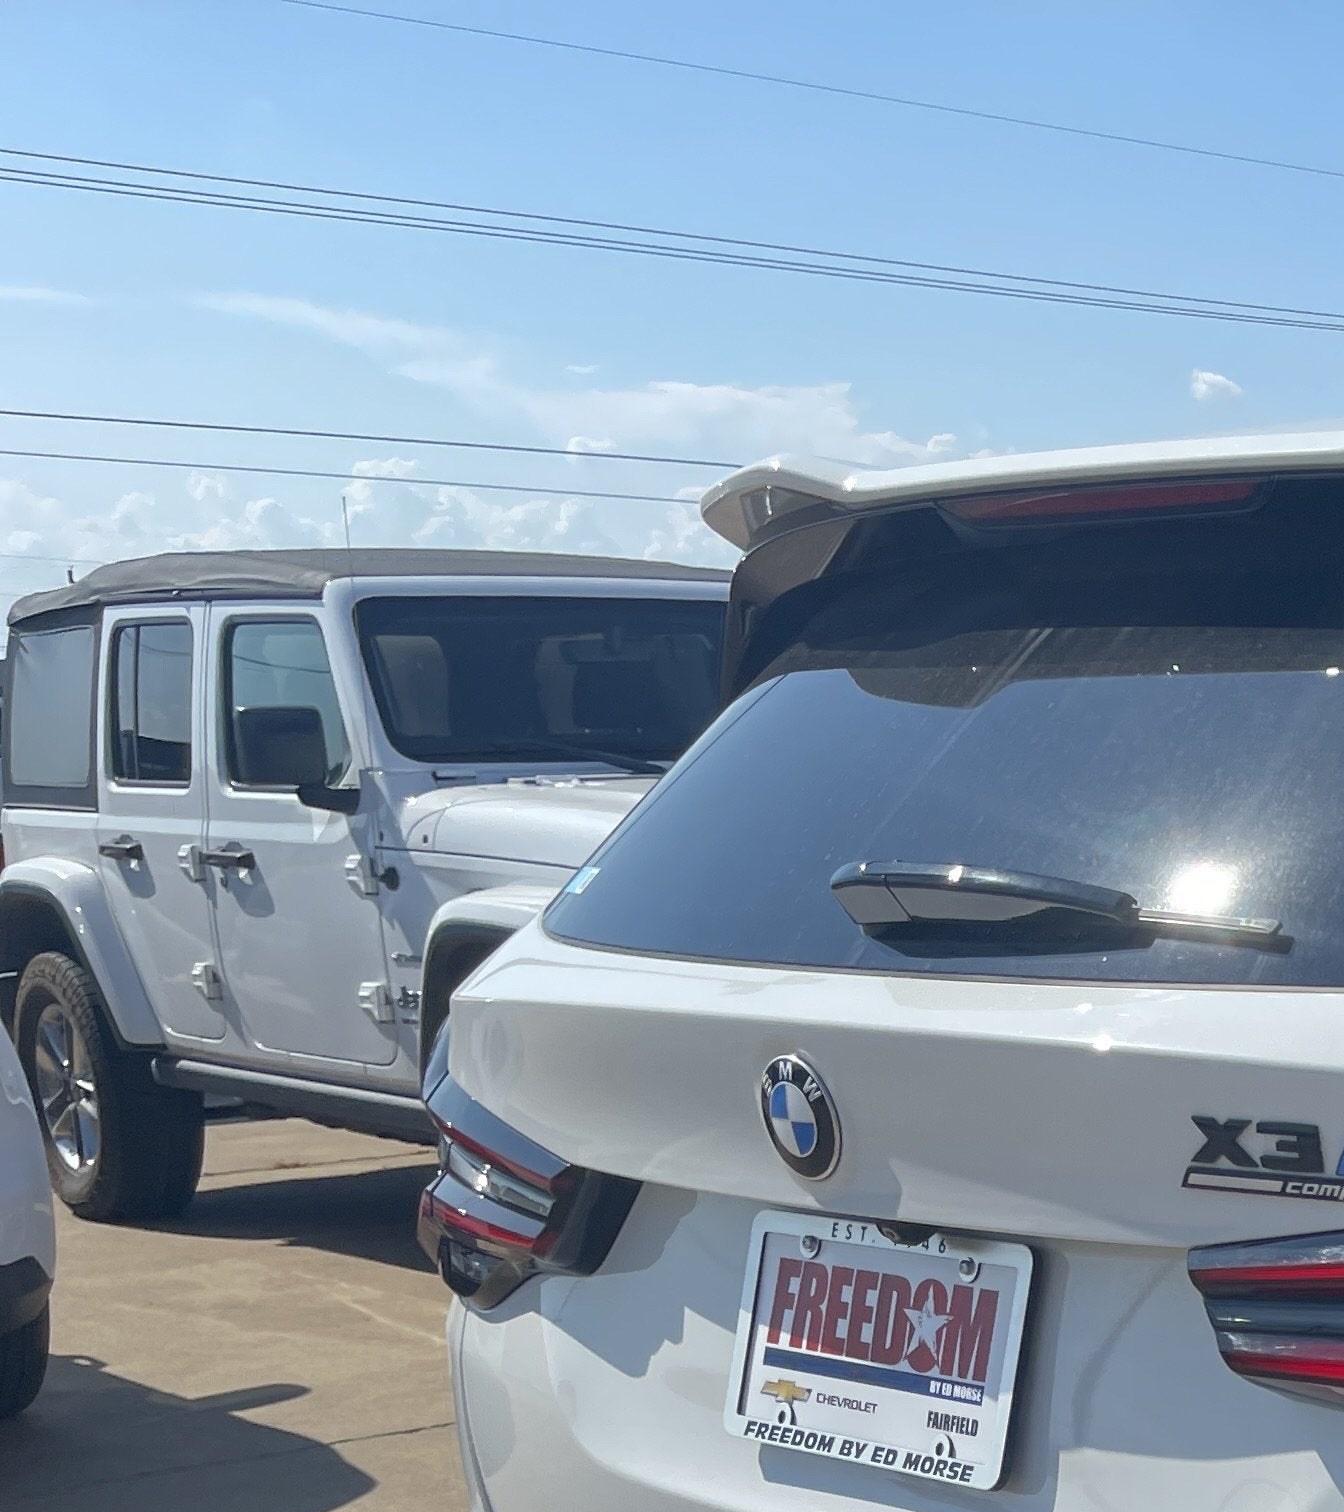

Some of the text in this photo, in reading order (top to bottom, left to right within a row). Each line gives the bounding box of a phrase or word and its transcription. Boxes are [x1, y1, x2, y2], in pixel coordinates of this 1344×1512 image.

[1190, 1115, 1325, 1173] X3
[766, 1257, 1000, 1383] FREEDOM
[815, 1392, 878, 1415] CHEVROLET
[929, 1380, 983, 1403] BY ED MORSE
[926, 1410, 980, 1437] FAIRFIELD
[743, 1420, 975, 1483] FREEDOM BY ED MORSE
